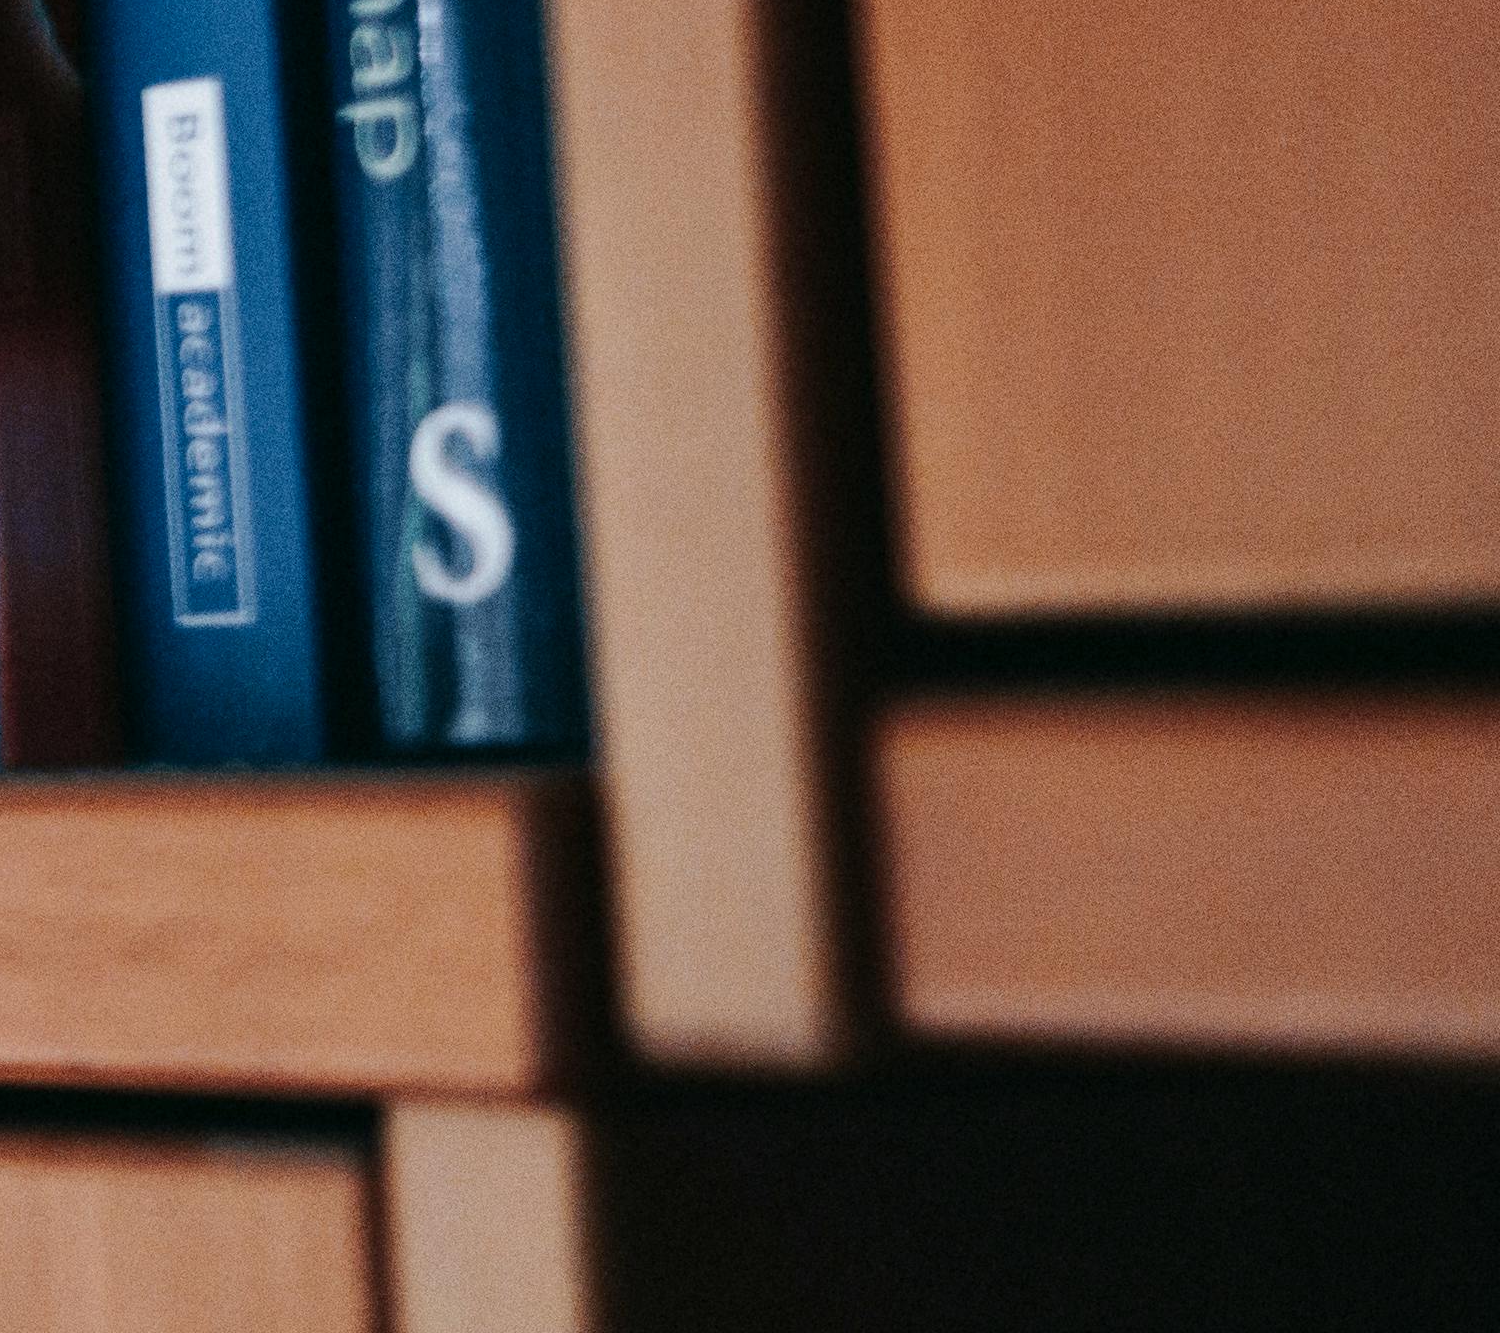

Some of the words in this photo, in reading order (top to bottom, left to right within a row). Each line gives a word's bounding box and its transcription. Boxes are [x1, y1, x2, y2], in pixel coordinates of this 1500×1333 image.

[164, 110, 207, 276] Boom
[176, 300, 235, 583] academic
[408, 400, 515, 606] S
